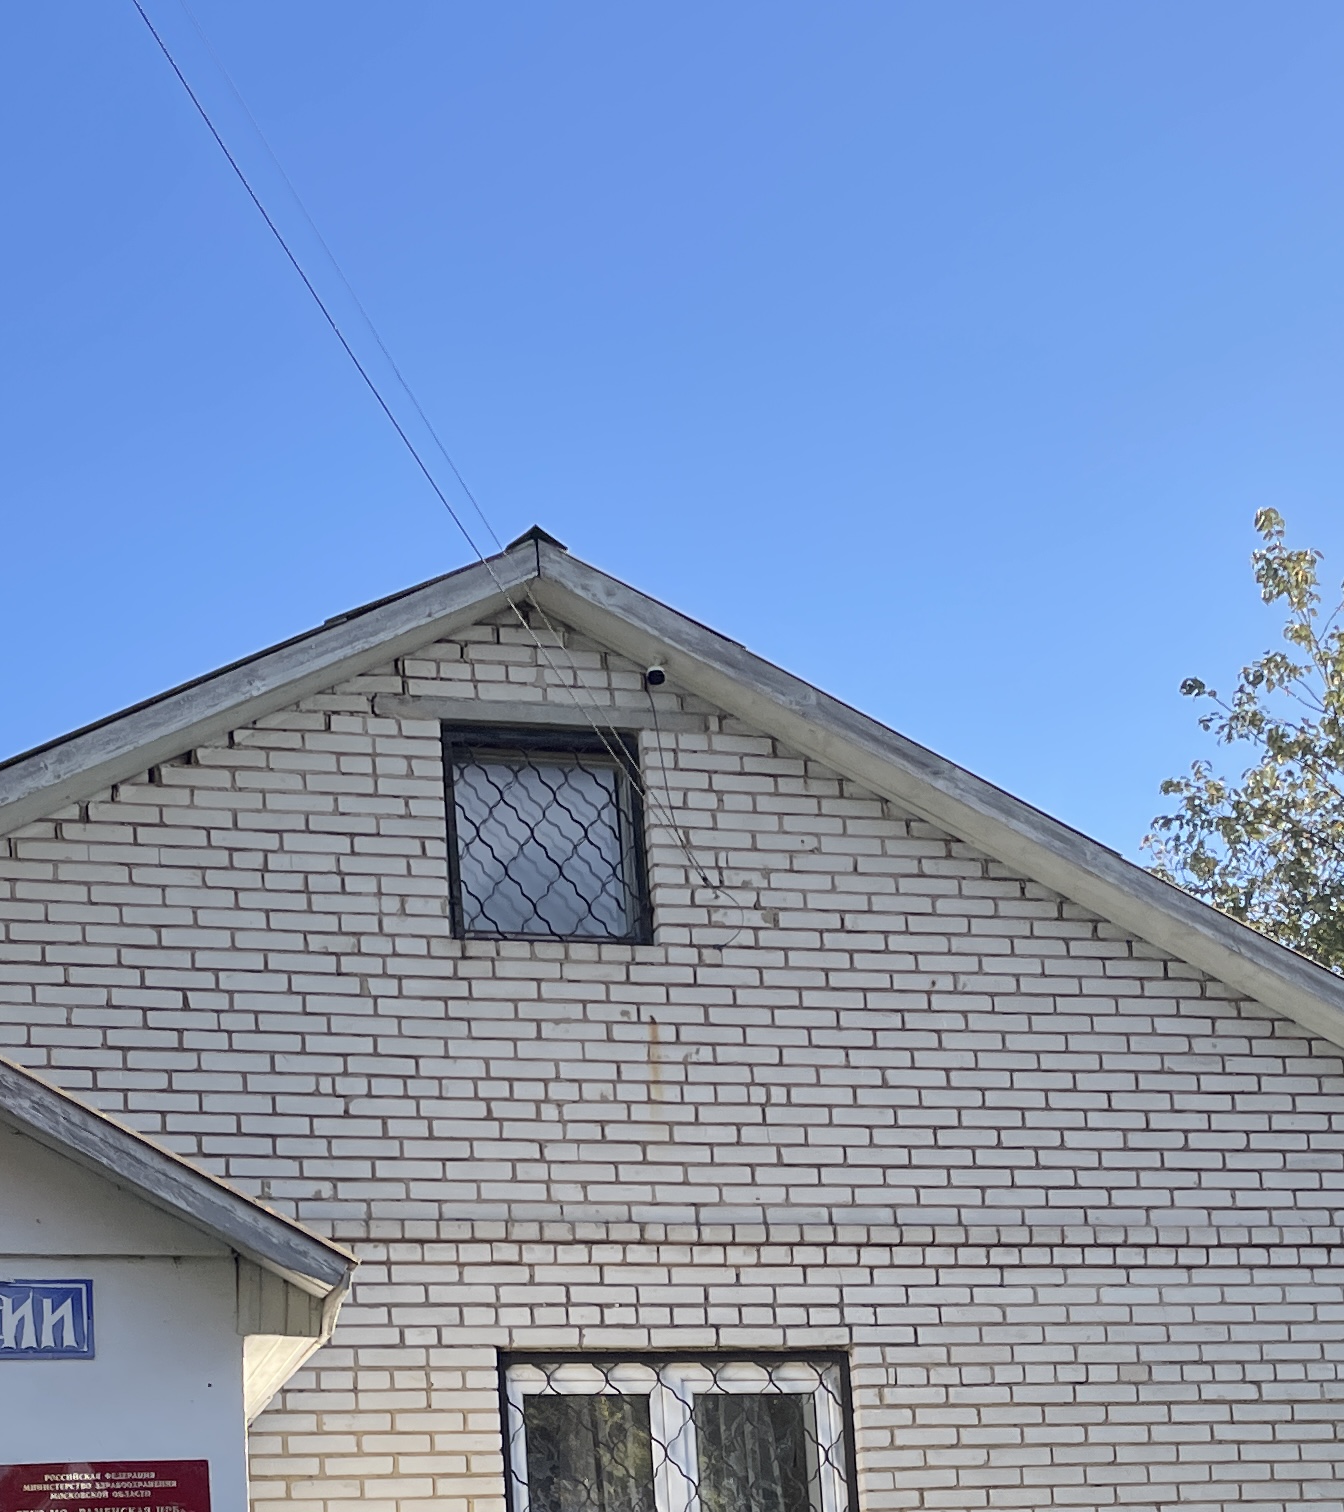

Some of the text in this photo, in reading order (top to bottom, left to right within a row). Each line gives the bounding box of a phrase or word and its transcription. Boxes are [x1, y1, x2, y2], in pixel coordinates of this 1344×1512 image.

[43, 1471, 156, 1482] РОССИЙСКАЯ ФЕДЕРАЦИЯ
[22, 1480, 177, 1492] МИНИСТЕРСТВО ЗДРАВООХРАНЕНИЯ
[49, 1489, 152, 1500] МОСКОВСКОЙ ОБЛАСТИ
